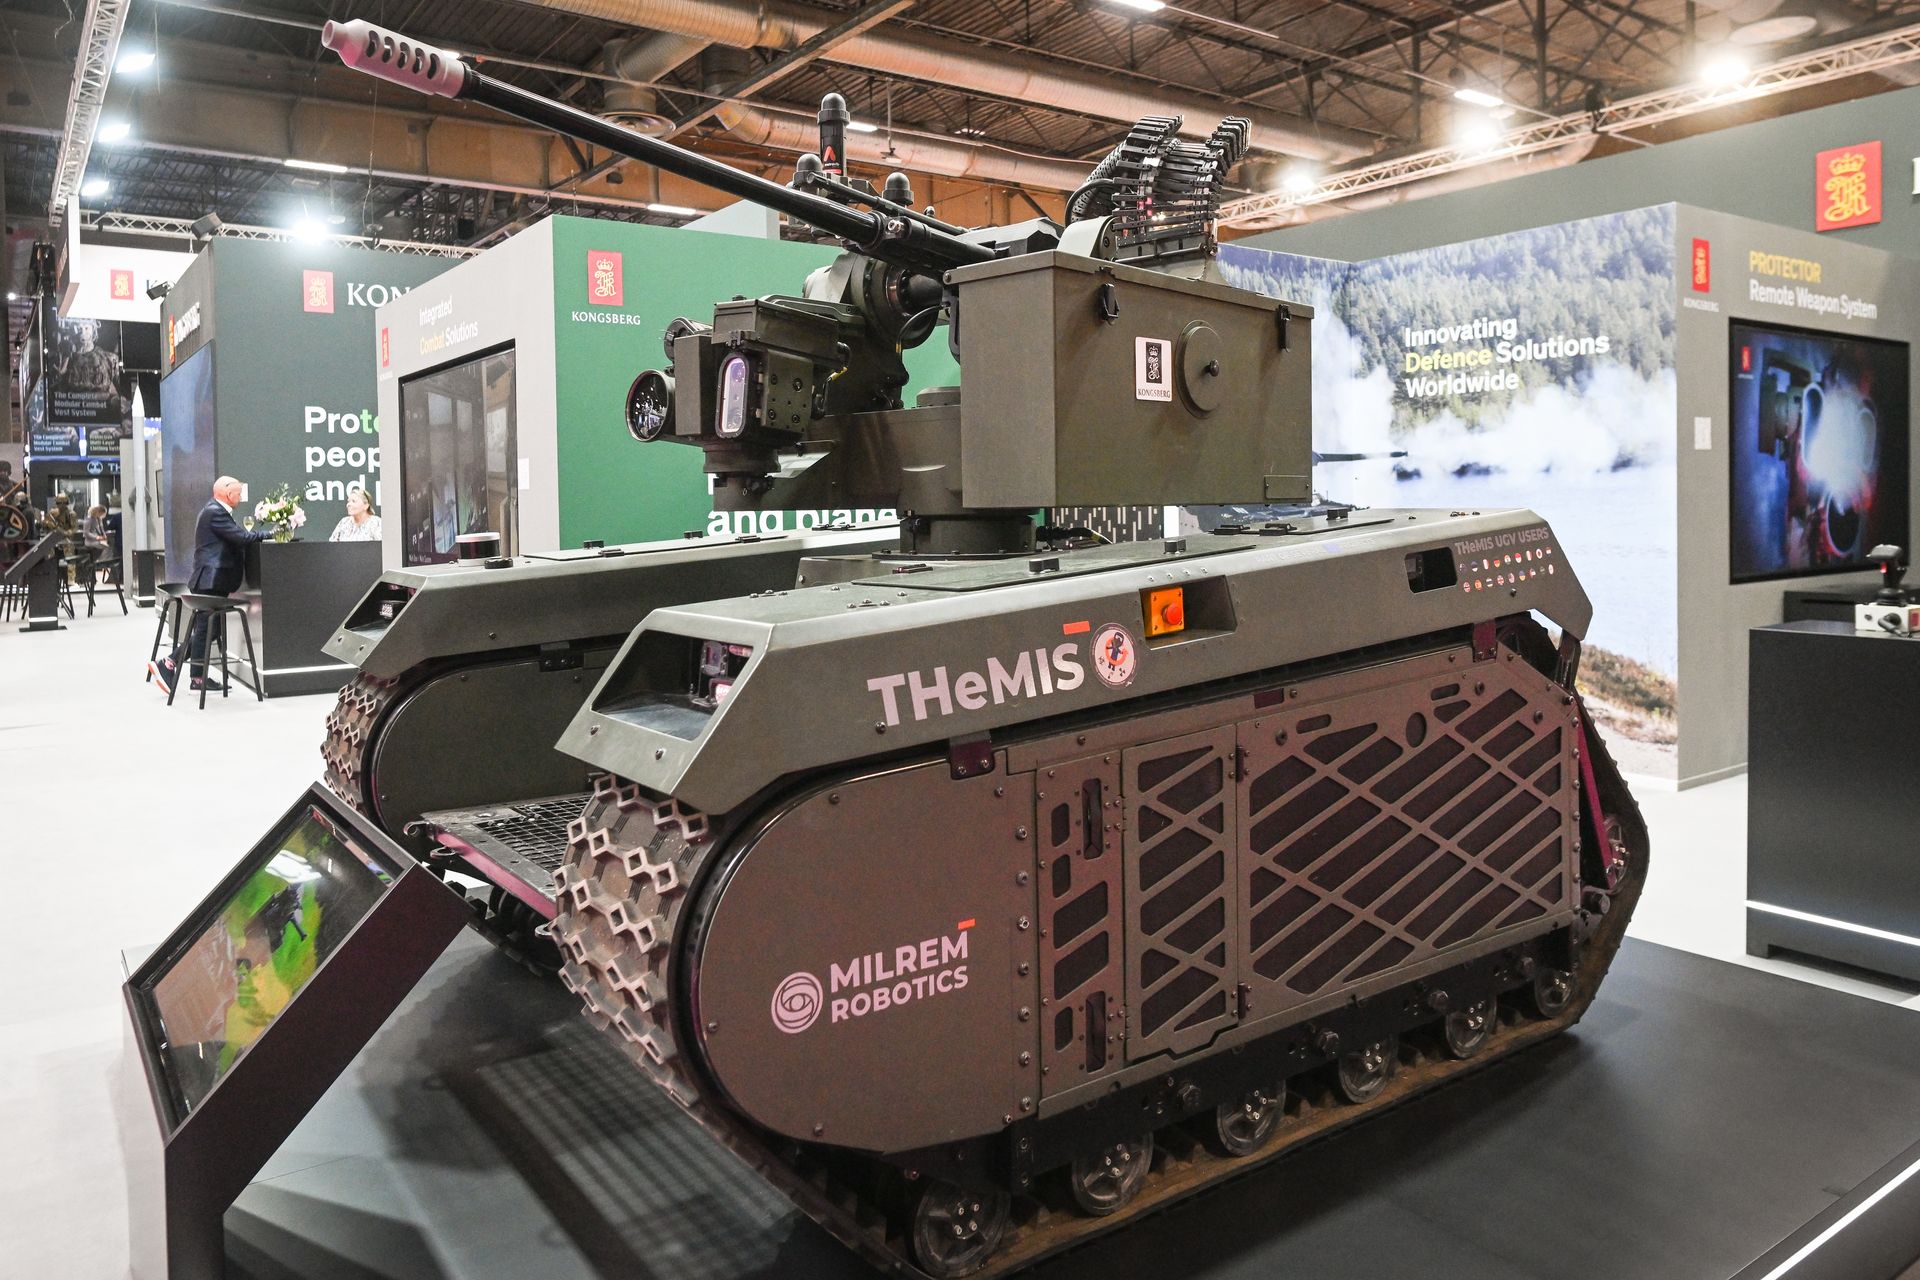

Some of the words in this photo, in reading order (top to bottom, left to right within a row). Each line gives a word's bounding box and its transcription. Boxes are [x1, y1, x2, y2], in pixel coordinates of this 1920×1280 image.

[1749, 250, 1822, 283] PROTECTOR
[419, 295, 453, 326] Integrated
[1750, 278, 1795, 306] Remote
[1795, 286, 1840, 315] Weapon
[1840, 294, 1878, 320] System
[571, 311, 641, 325] KONGSBERG
[1405, 317, 1518, 347] Innovating
[445, 321, 478, 347] Solutions
[1405, 348, 1493, 373] Defence
[1496, 335, 1610, 364] Solutions
[1137, 388, 1171, 398] KONGSBERG
[1405, 369, 1520, 398] Worldwide
[1455, 536, 1494, 555] THeMIS
[1494, 533, 1519, 548] UGV
[1516, 527, 1550, 544] USERS
[867, 643, 1085, 727] THeMIS
[830, 931, 968, 993] MILREM
[831, 965, 969, 1023] ROBOTICS
